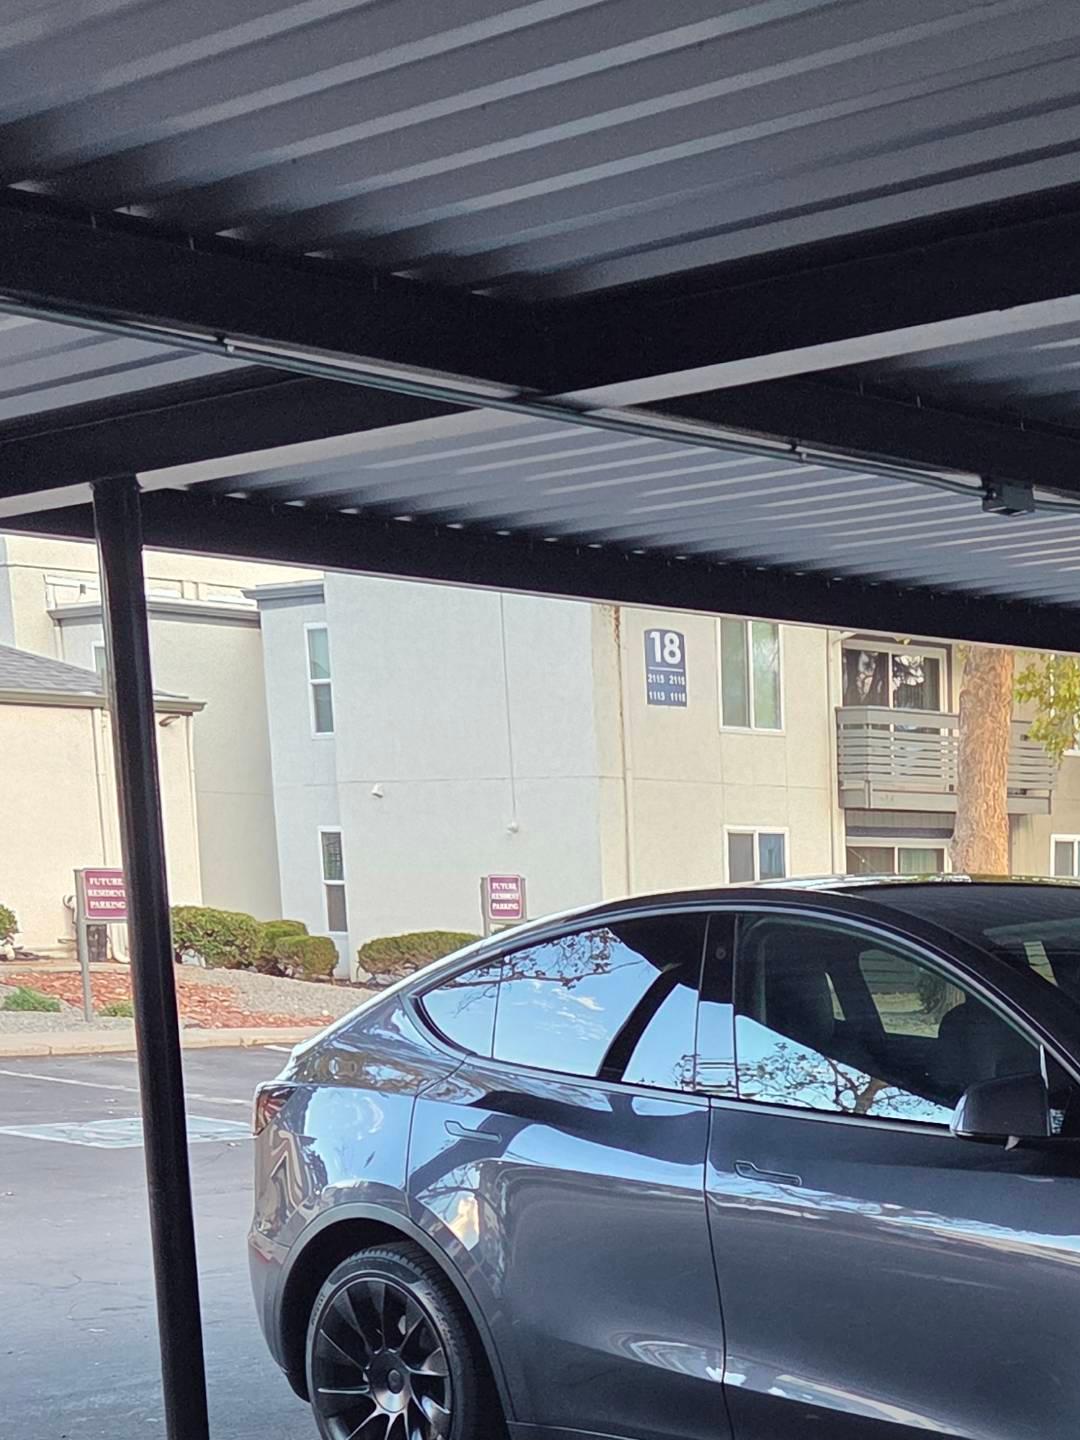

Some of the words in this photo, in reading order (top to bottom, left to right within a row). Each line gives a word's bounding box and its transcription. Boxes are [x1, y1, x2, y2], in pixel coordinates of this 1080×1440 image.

[650, 631, 681, 664] 18
[89, 878, 124, 886] FUTURE
[90, 901, 127, 909] PARKING
